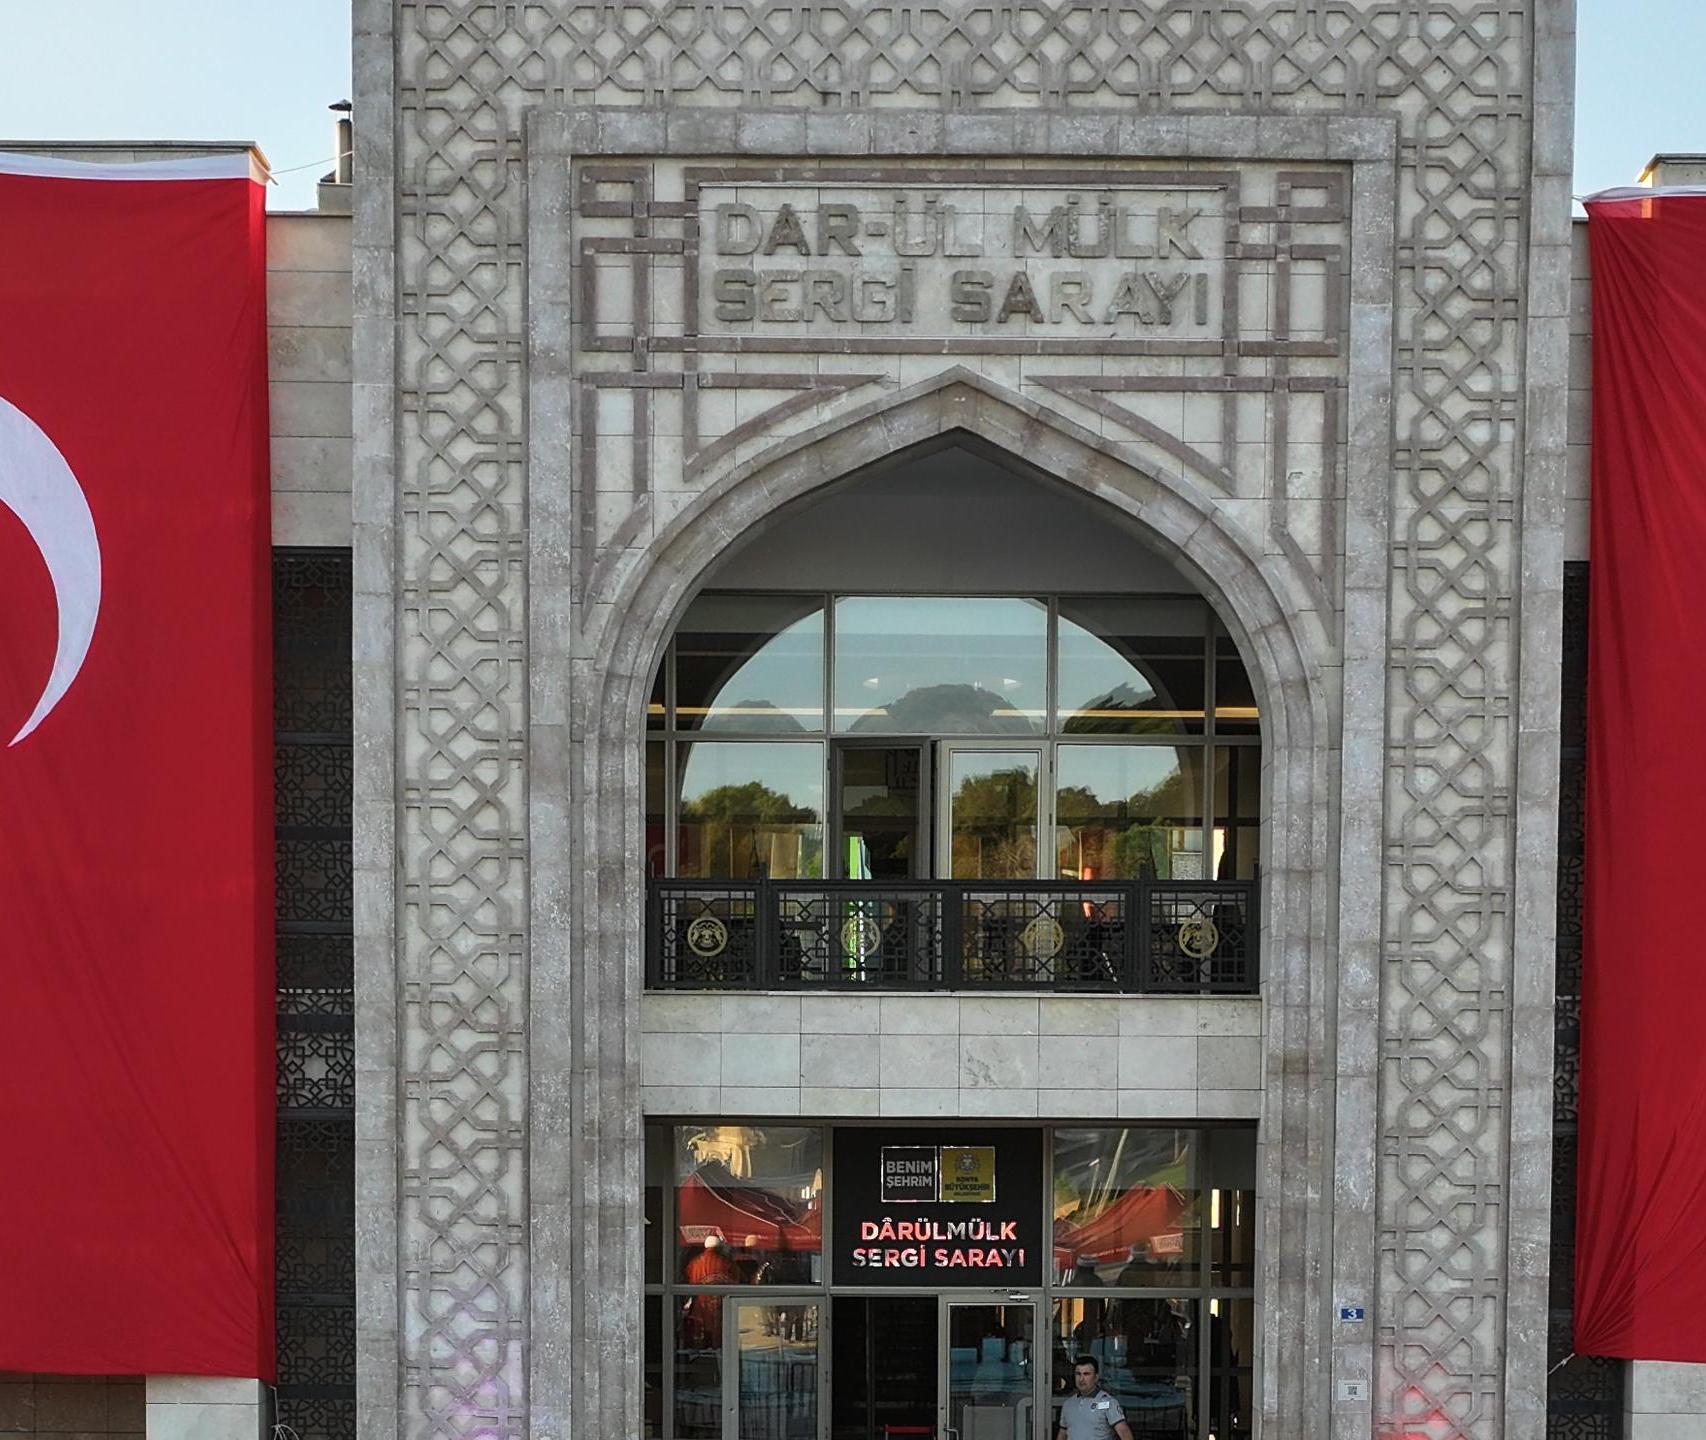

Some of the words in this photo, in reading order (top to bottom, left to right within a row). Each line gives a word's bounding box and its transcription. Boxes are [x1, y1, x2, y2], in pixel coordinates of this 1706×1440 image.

[715, 192, 986, 258] DAR-ÜL
[1012, 191, 1204, 260] MÜLK
[713, 267, 914, 324] SERGİ
[950, 269, 1208, 325] SARAYI
[861, 1217, 1018, 1241] DÂRÜLMÜLK
[852, 1244, 926, 1268] SERGİ
[934, 1248, 1025, 1268] SARAYI
[1347, 1308, 1359, 1320] 3
